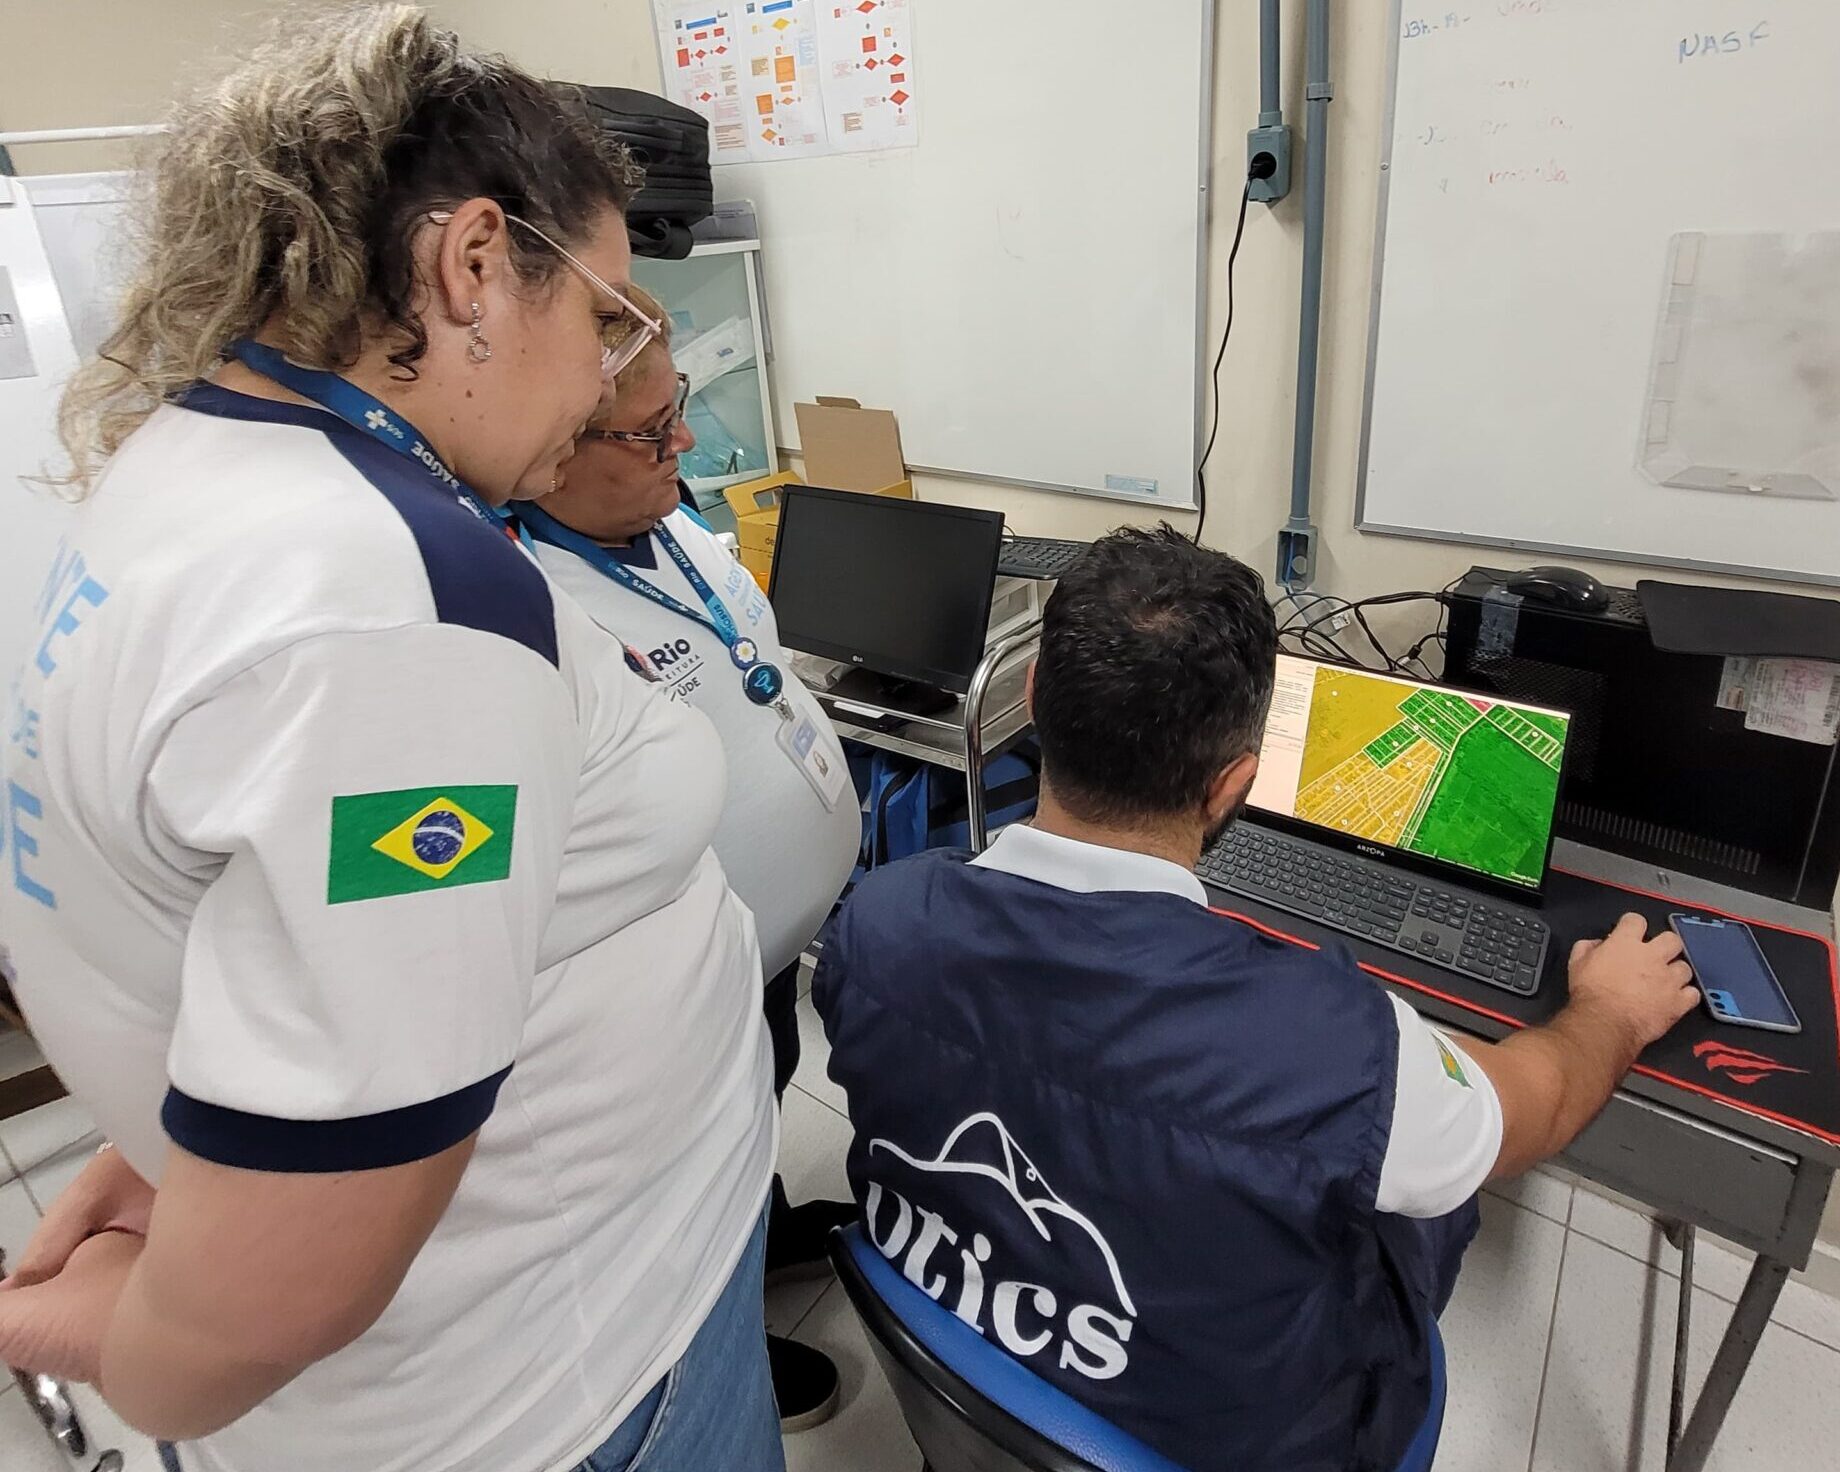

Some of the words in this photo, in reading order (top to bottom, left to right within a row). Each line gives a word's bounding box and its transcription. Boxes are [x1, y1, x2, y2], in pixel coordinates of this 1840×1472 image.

[1679, 20, 1770, 64] NASF
[632, 579, 664, 600] SAÚDE
[647, 638, 691, 671] Rio
[665, 654, 700, 680] EITURA
[670, 676, 701, 702] ÚDE
[866, 1181, 1133, 1379] otics
